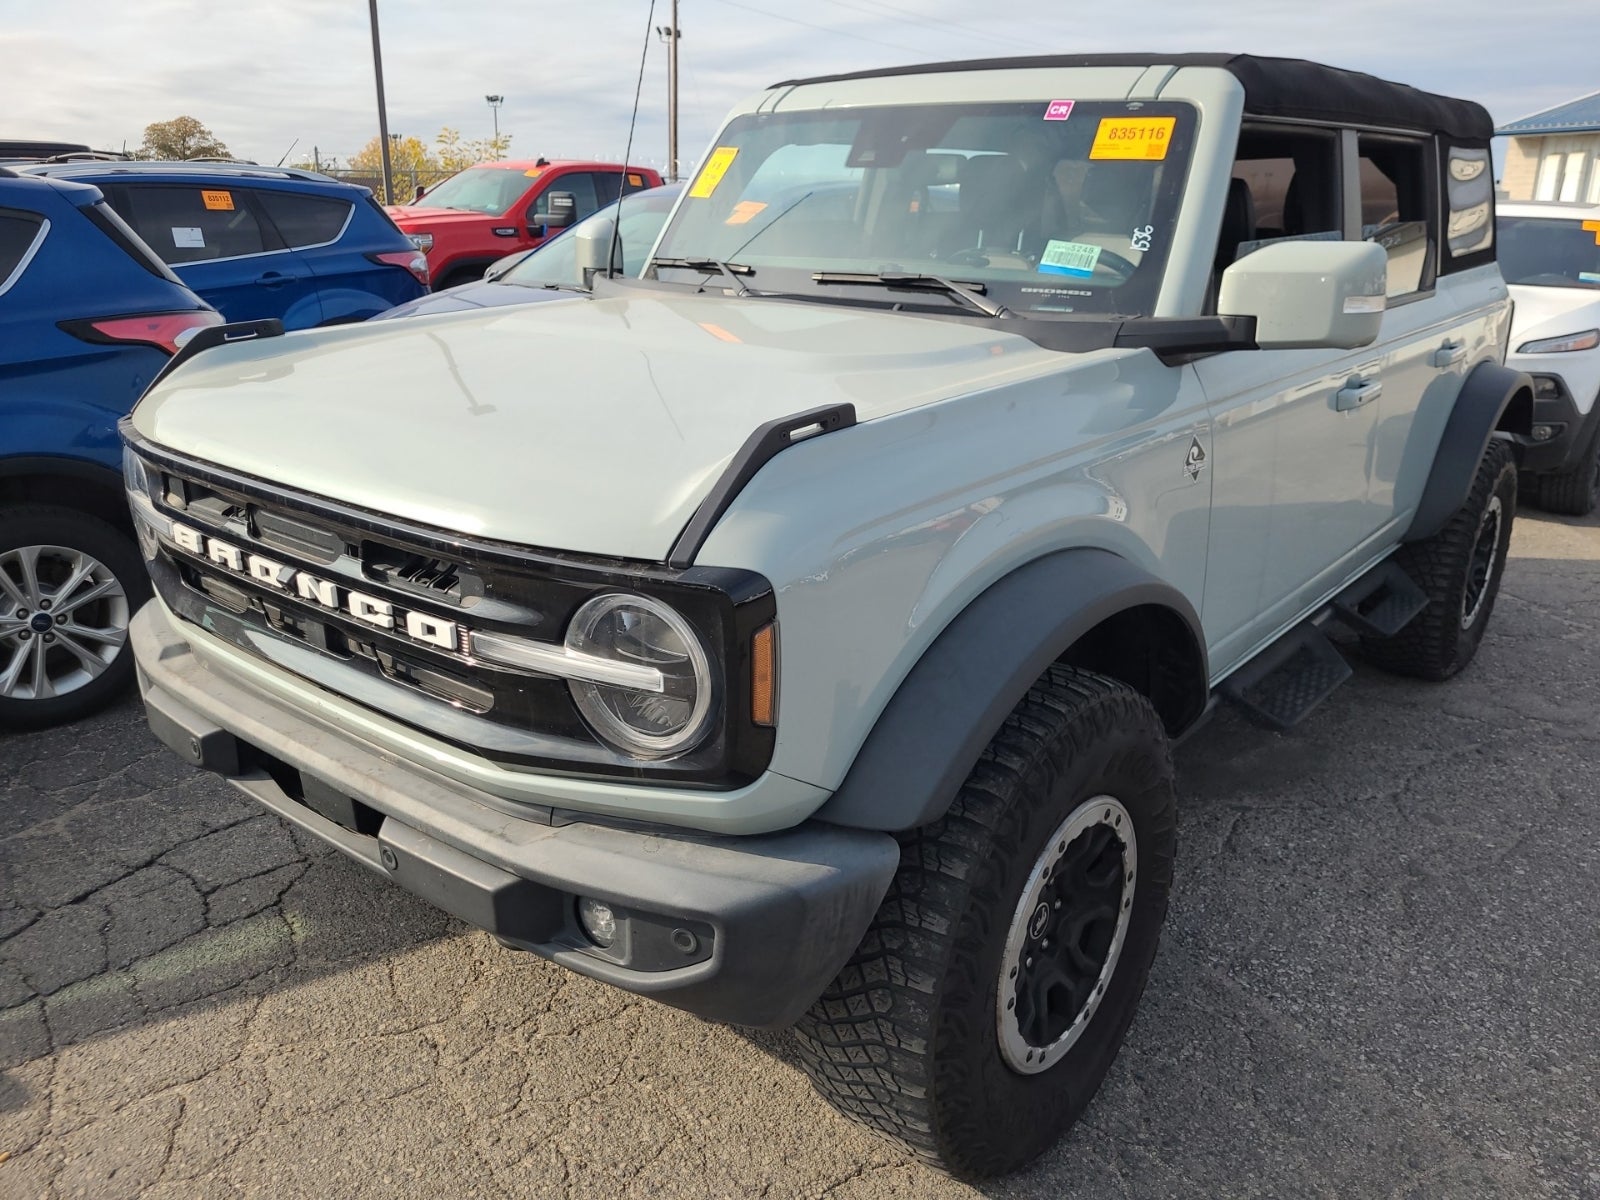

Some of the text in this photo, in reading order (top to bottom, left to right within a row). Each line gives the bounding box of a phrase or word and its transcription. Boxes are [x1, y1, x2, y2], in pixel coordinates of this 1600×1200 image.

[1050, 105, 1069, 115] CR
[1108, 127, 1166, 140] 835116
[1130, 225, 1153, 251] 1536
[173, 522, 457, 650] BRONCO
